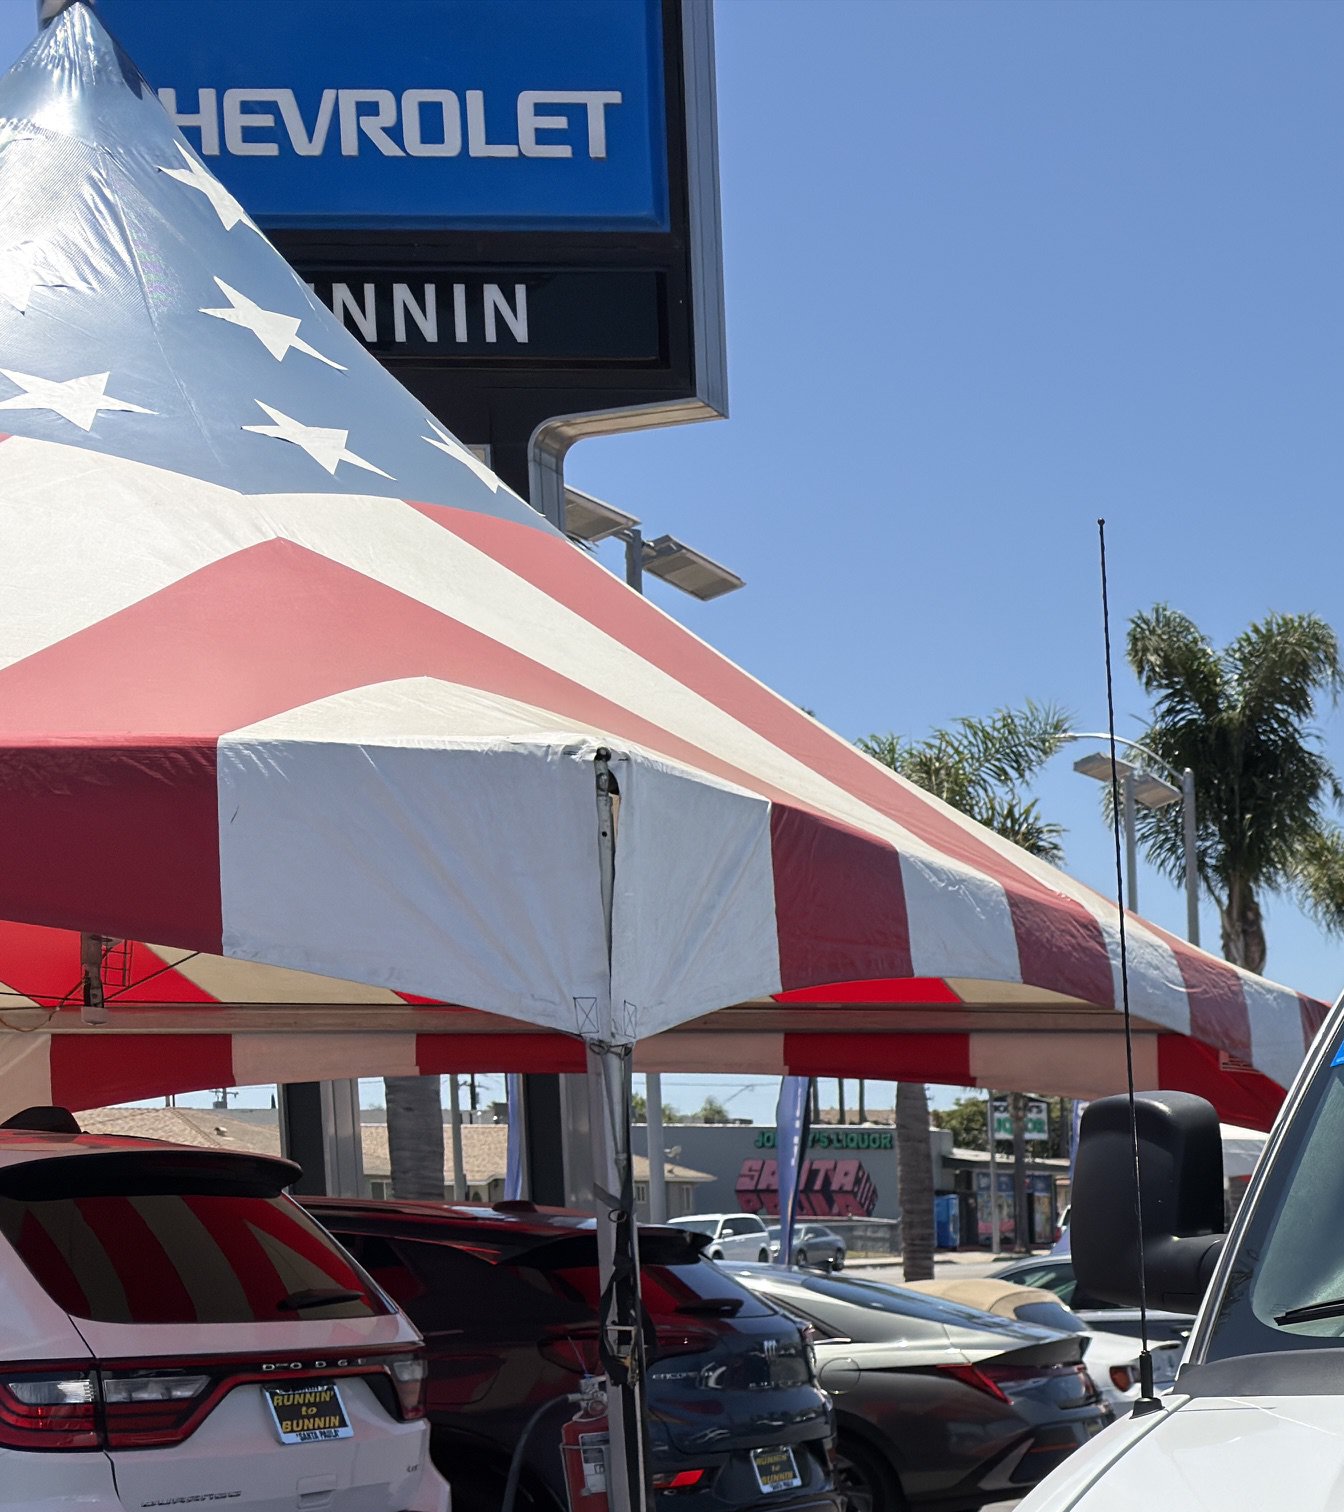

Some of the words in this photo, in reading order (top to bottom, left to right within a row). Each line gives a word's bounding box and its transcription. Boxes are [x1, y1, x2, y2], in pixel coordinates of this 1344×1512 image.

[157, 87, 622, 159] HEVROLET
[306, 282, 529, 344] NNIN
[831, 1131, 893, 1149] LIQUOR
[262, 1358, 368, 1371] DODGE
[273, 1389, 335, 1407] RUNNIN'
[301, 1406, 318, 1416] to
[282, 1415, 340, 1433] BUNNIN
